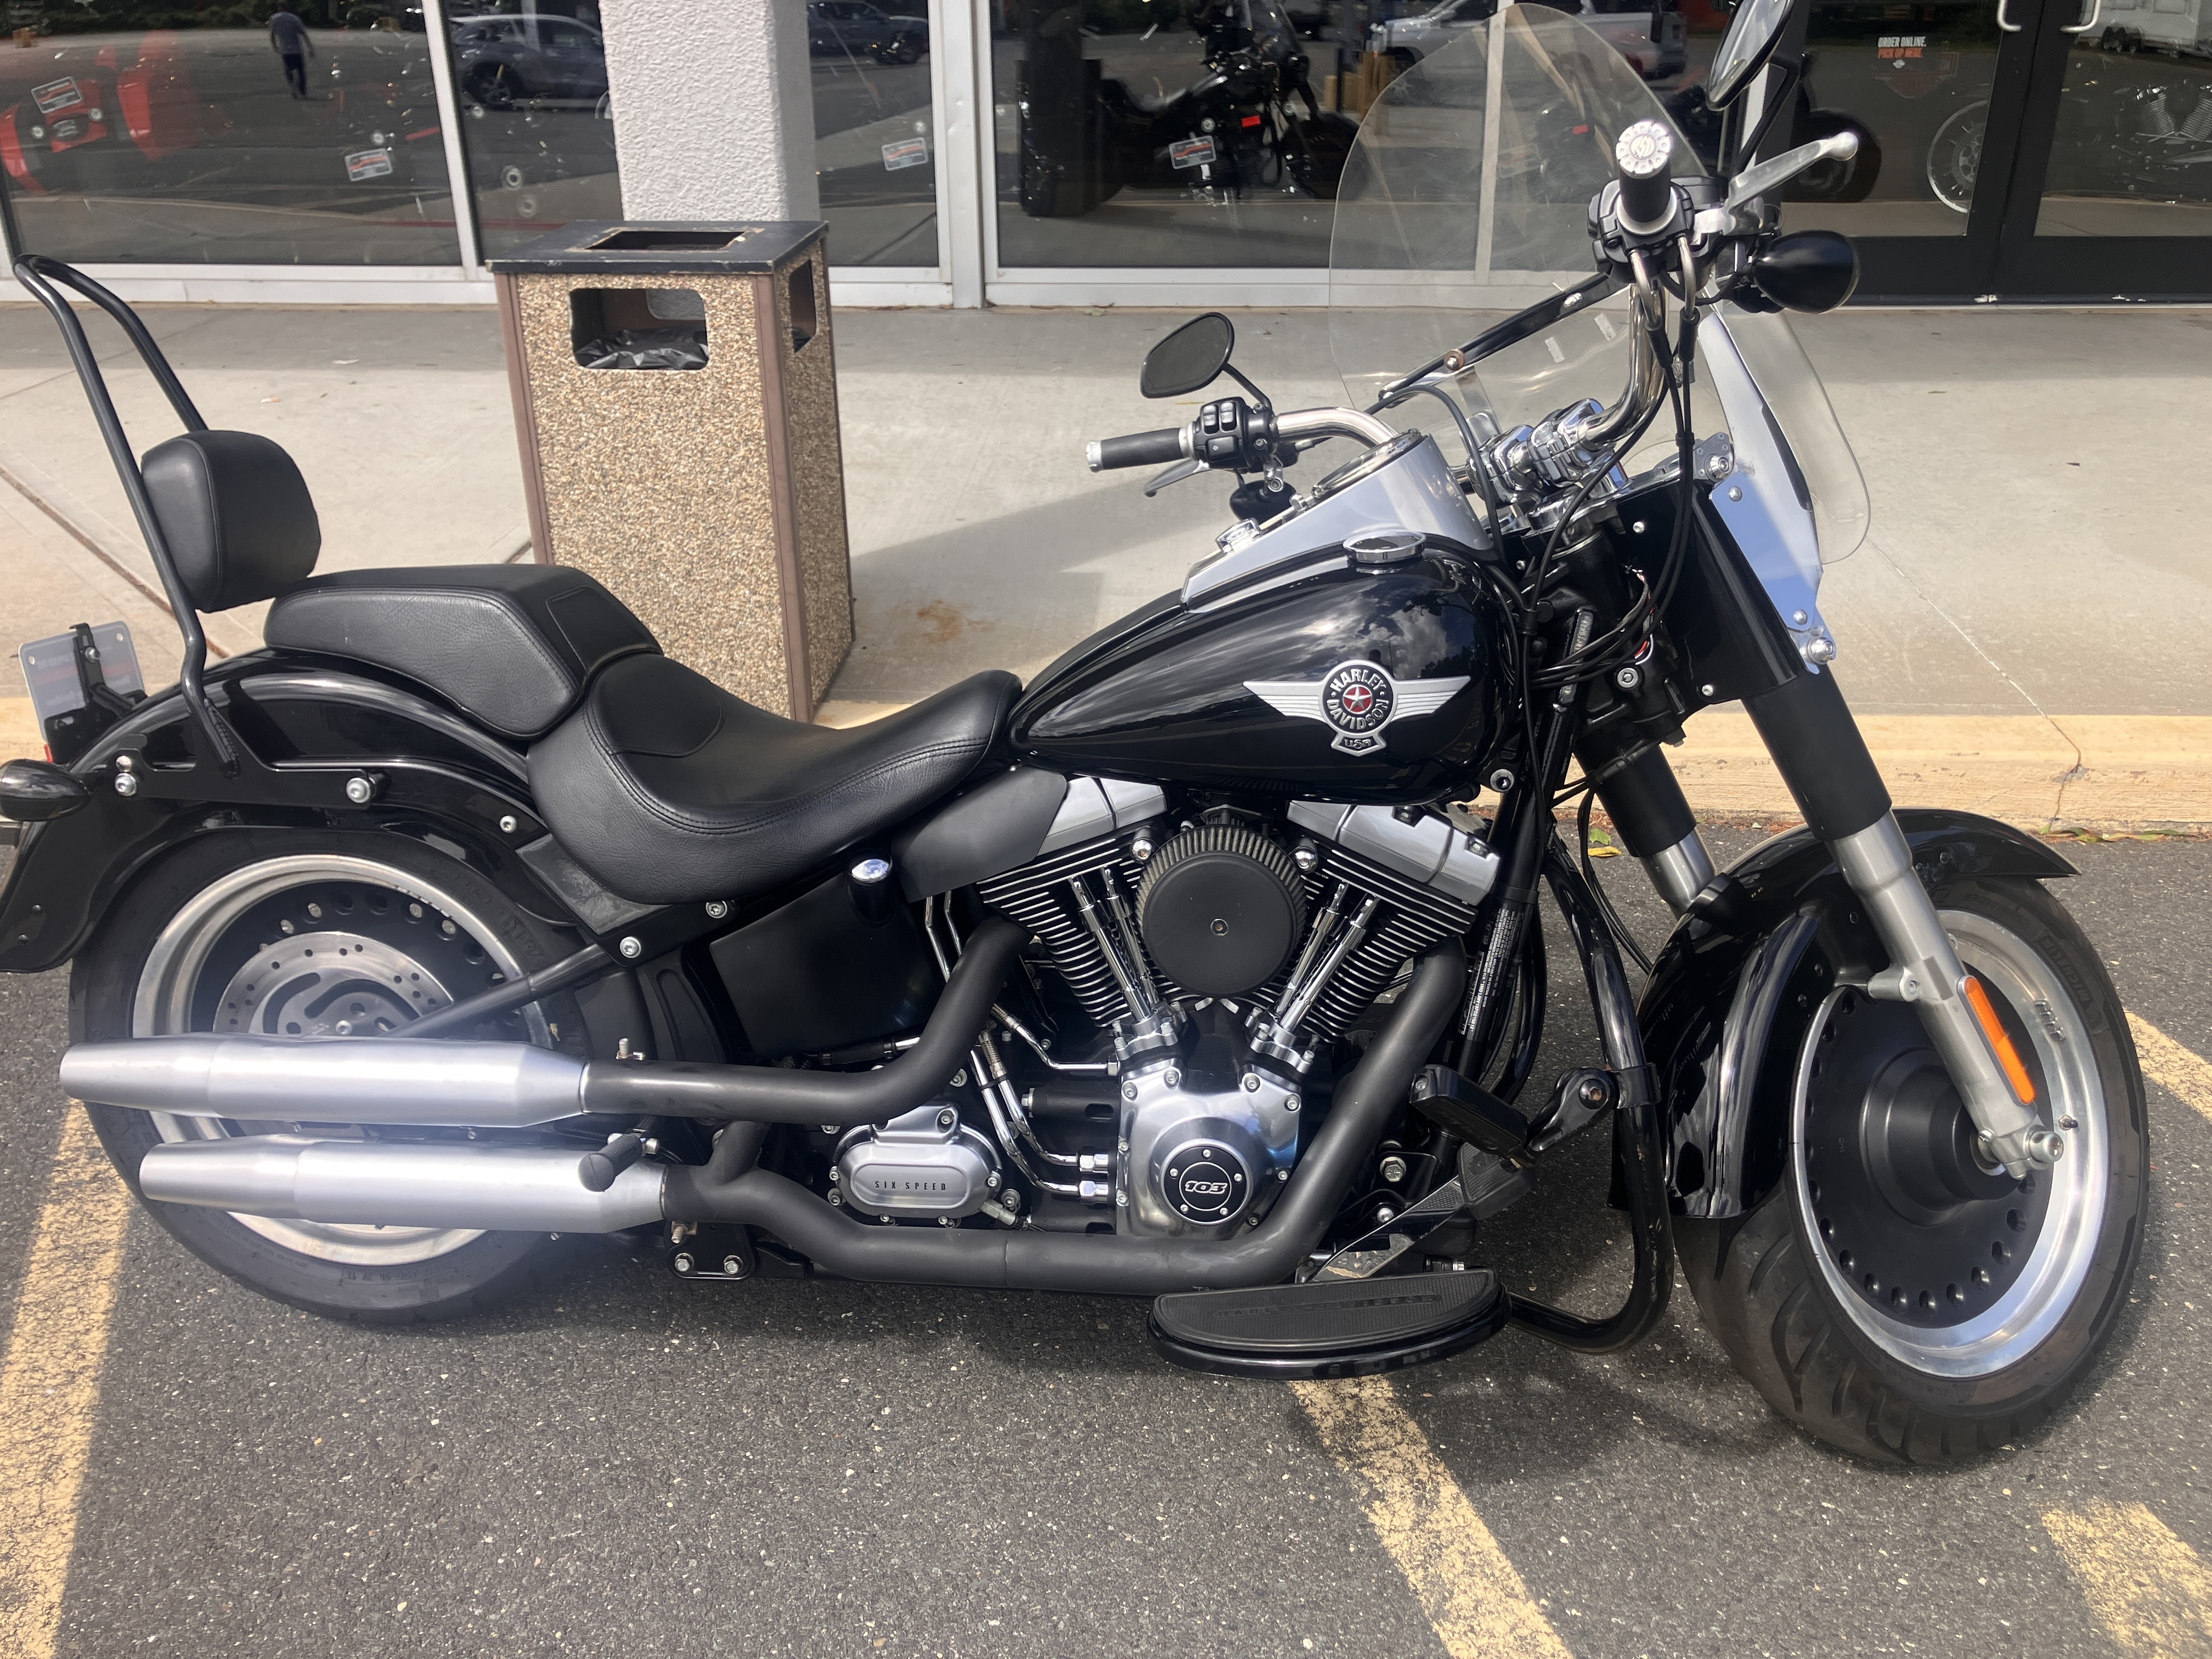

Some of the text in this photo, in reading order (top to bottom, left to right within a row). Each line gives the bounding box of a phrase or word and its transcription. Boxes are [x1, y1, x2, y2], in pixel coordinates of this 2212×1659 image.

[1878, 37, 1900, 48] ORDER
[1330, 668, 1387, 693] HARLEY
[1327, 698, 1389, 730] DAVIDSON
[875, 1181, 946, 1191] SIX SPEED
[1184, 1180, 1228, 1194] 103
